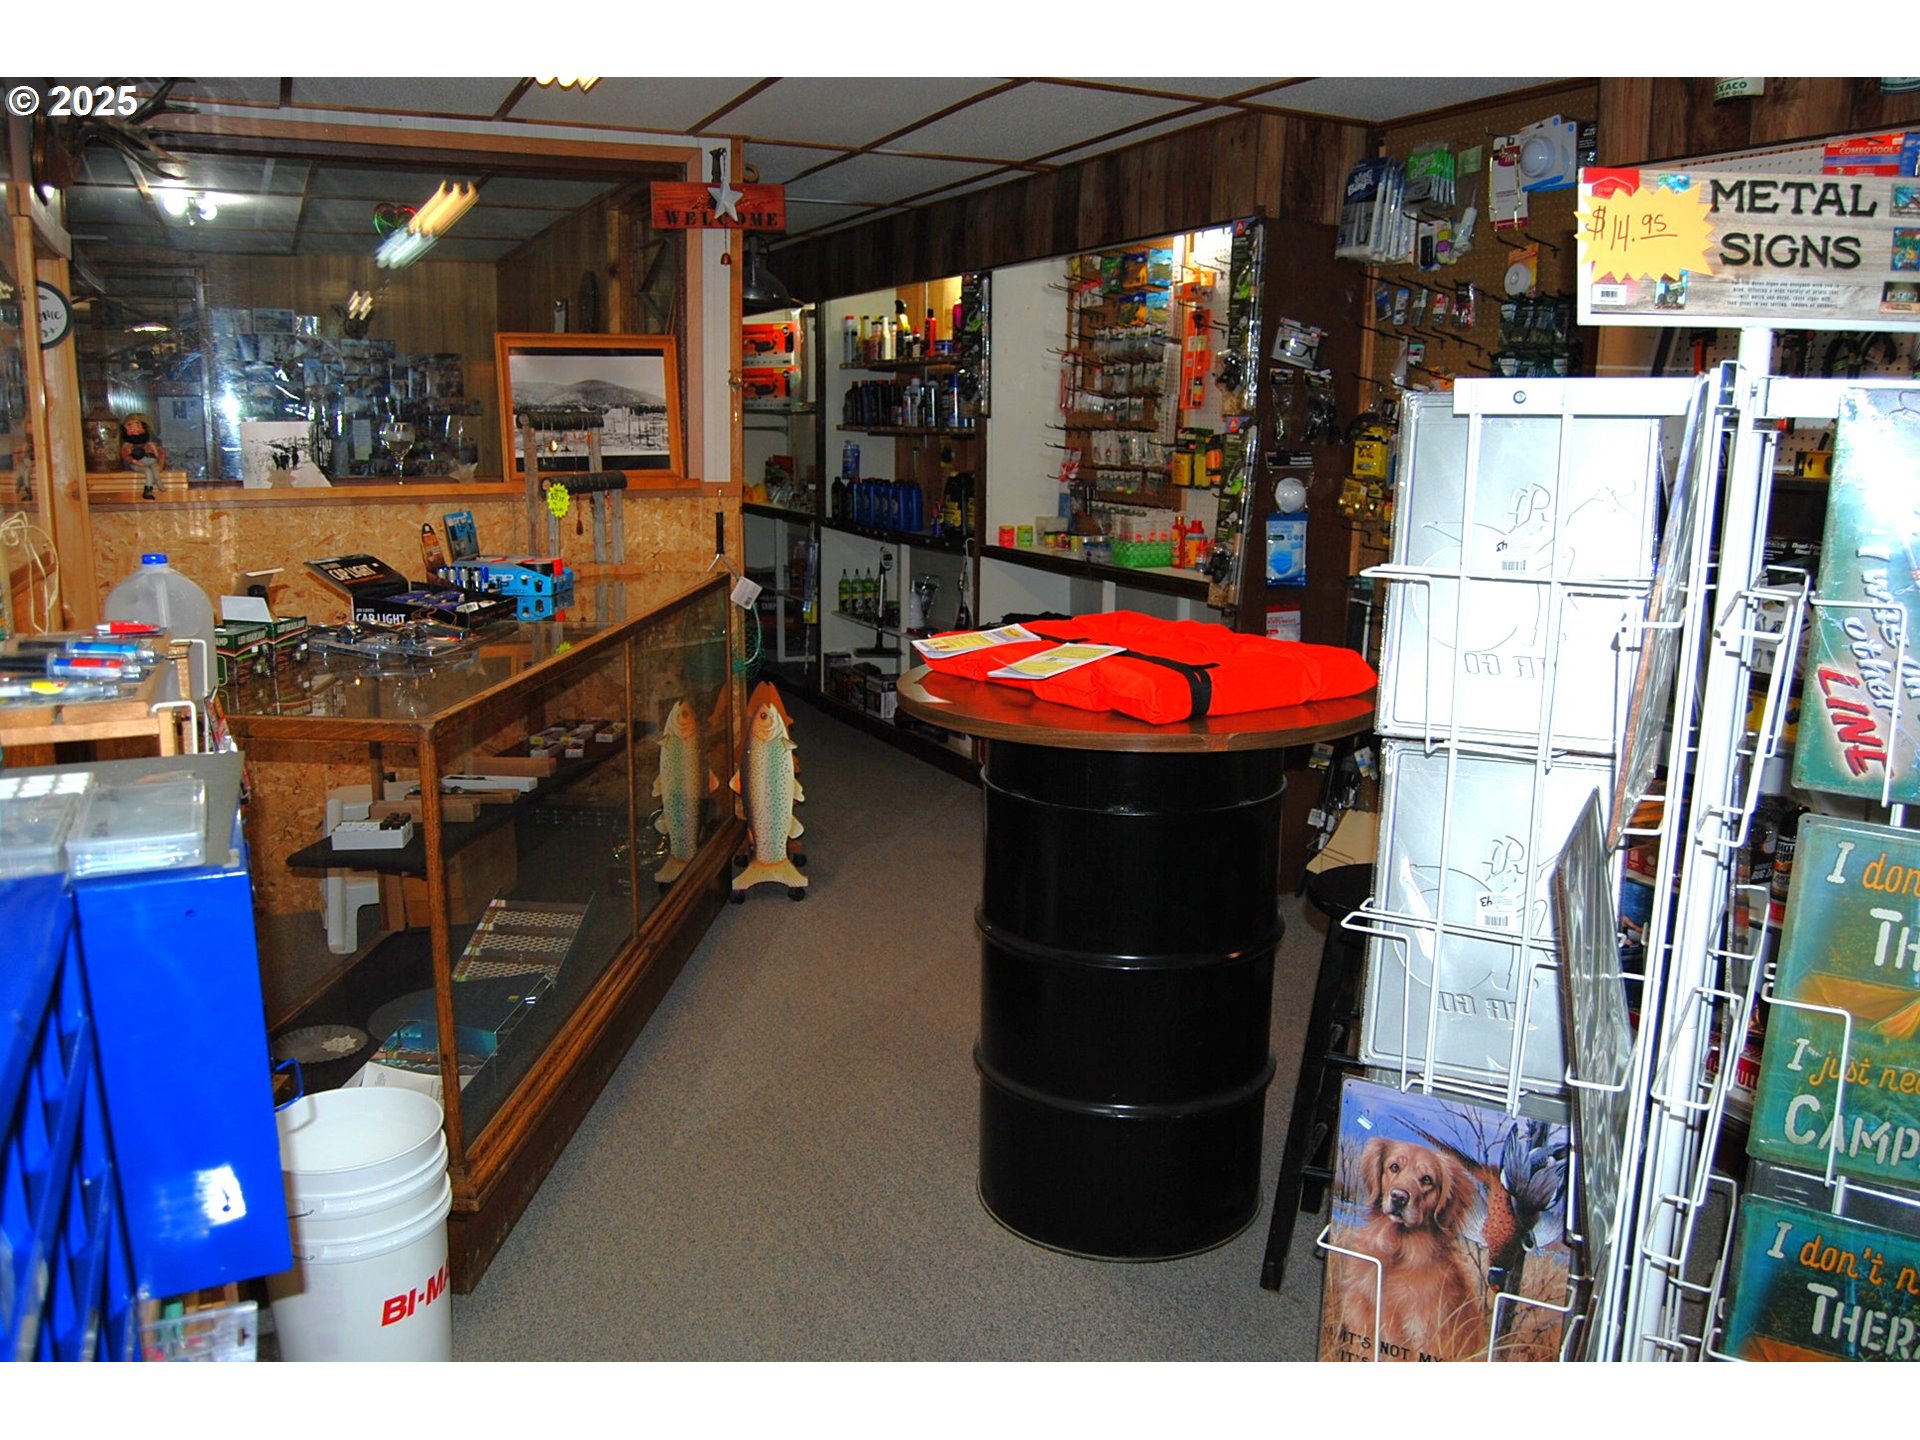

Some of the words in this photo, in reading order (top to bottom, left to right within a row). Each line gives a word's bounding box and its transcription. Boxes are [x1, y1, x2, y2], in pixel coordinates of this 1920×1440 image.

[1839, 147, 1871, 155] COMBO
[664, 210, 778, 226] WELOME
[1710, 179, 1878, 217] METAL
[1585, 205, 1678, 252] $14.95
[1719, 232, 1862, 269] SIGNS
[1843, 615, 1903, 719] other
[1816, 665, 1896, 778] LINE
[1826, 840, 1856, 884] I
[1786, 1037, 1810, 1071] I
[1808, 1050, 1872, 1086] just
[1766, 1220, 1793, 1259] I
[1799, 1234, 1886, 1286] don't
[1340, 1327, 1371, 1350] IT'S
[1380, 1340, 1410, 1360] NOT
[1806, 1282, 1920, 1360] THER
